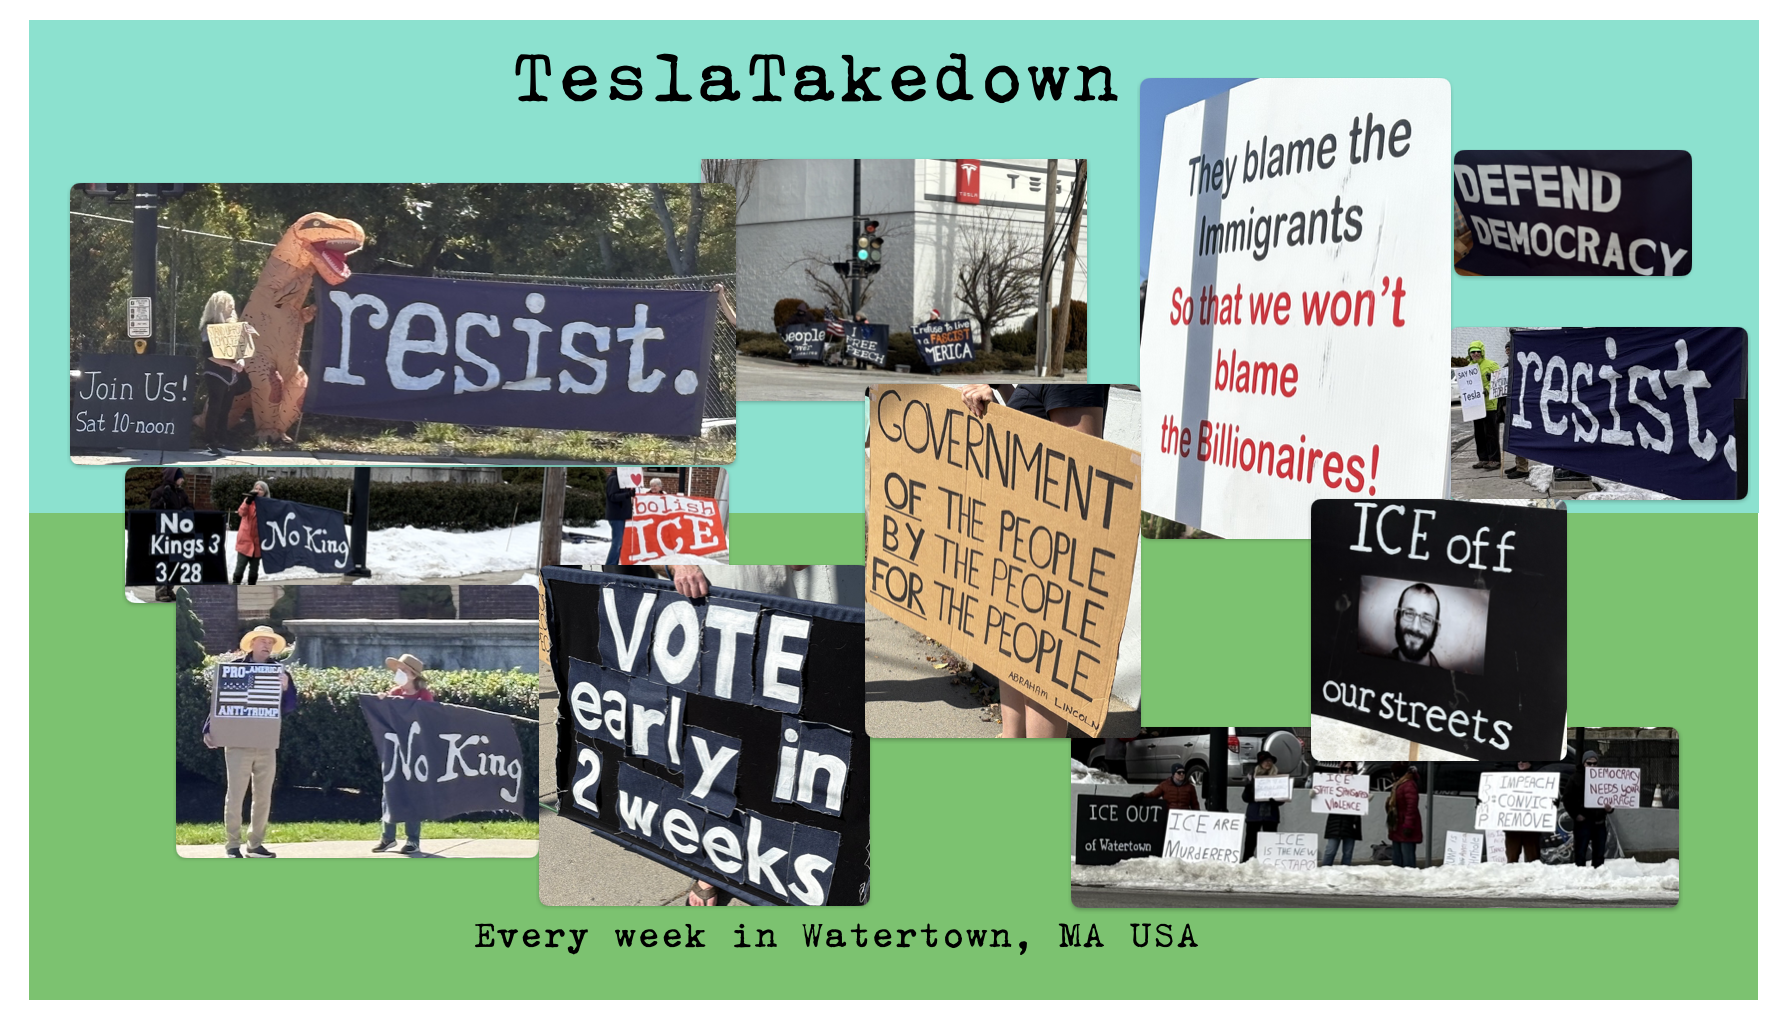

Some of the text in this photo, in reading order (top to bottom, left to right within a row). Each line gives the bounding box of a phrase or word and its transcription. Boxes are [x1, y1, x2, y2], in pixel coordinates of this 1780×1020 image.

[1189, 112, 1411, 200] They blame the
[1454, 164, 1621, 212] DEFEND
[1199, 196, 1363, 261] Immigrants
[1471, 215, 1688, 276] DEMOCRACY
[1170, 276, 1406, 327] So that we won't
[910, 321, 970, 334] I refuse to live
[930, 328, 970, 345] FASCIST
[323, 290, 698, 395] resist.
[846, 345, 885, 364] PEECH
[1215, 348, 1298, 397] blame
[1458, 368, 1478, 379] SAY NO
[79, 371, 188, 402] Join Us!
[1463, 390, 1481, 401] Tesla
[1512, 337, 1737, 472] resist.
[76, 410, 175, 435] Sat 10-noon
[878, 389, 1134, 530] GOVERNMENT
[1161, 414, 1379, 496] the Billionaires!
[634, 496, 715, 516] bolish
[160, 513, 194, 534] No
[884, 472, 1116, 598] OF THE PEOPLE
[151, 534, 220, 559] Kings 3
[261, 512, 350, 568] No King
[625, 514, 719, 561] ICE
[1350, 502, 1516, 573] ICE off
[155, 562, 202, 584] 3/28
[882, 514, 1105, 648] BY THE PEOPLE
[872, 556, 1101, 703] FOR THE PEOPLE
[602, 587, 811, 704] VOTE
[218, 705, 279, 717] ANTI-TRUMP
[1008, 671, 1100, 731] ABRAHAM LINCOLN
[1322, 680, 1513, 751] our streets
[570, 681, 848, 811] early in
[383, 721, 522, 803] No King
[1326, 774, 1351, 785] ICE
[1499, 776, 1556, 790] IMPEACH
[1590, 768, 1640, 784] DEMOCRACY
[1590, 783, 1618, 794] NEEDS
[1314, 785, 1334, 795] STATE
[1498, 793, 1557, 810] CONVICT
[1597, 794, 1636, 807] COURAGE
[1089, 804, 1162, 823] ICE OUT
[1325, 798, 1361, 811] VIOLENCE
[572, 748, 833, 907] 2 weeks
[1169, 812, 1240, 833] ICE ARE
[1497, 812, 1553, 829] REMOVE
[1085, 839, 1152, 852] of Watertown
[1263, 847, 1317, 857] IS THE NEW
[1275, 833, 1304, 846] ICE
